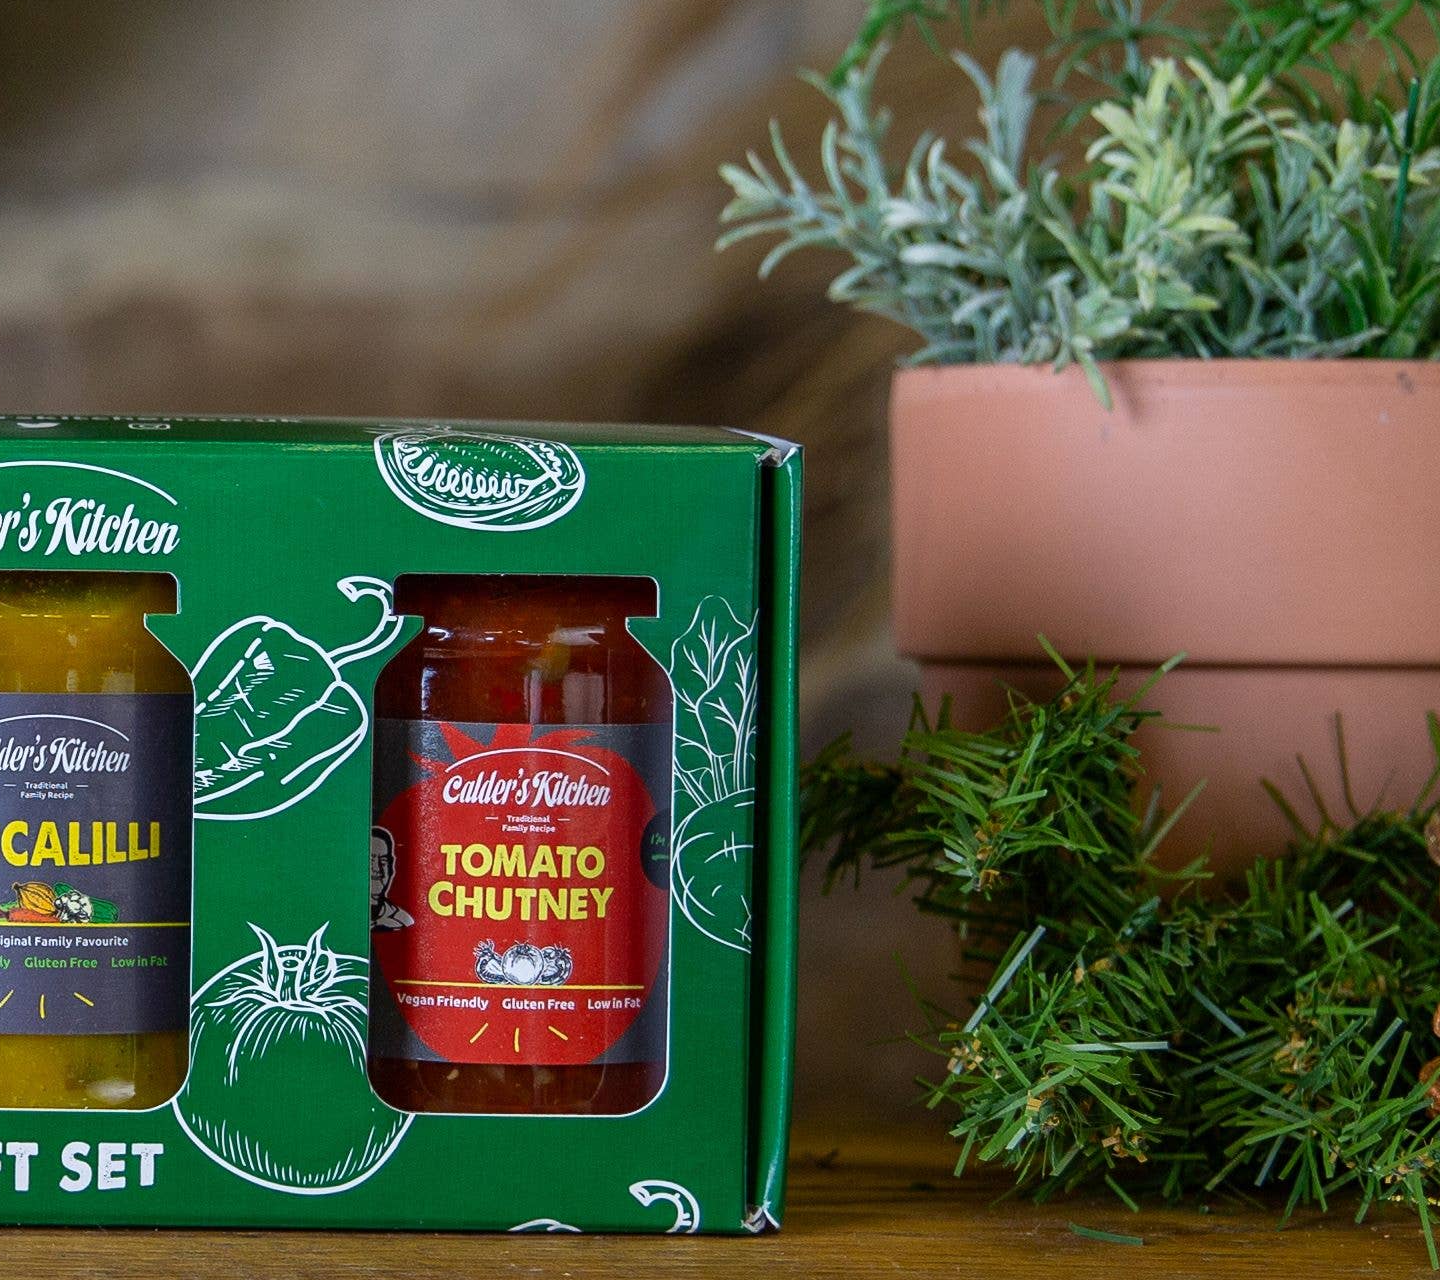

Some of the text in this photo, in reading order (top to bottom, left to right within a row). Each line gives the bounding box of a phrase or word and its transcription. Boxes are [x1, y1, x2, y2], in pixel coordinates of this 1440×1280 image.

[44, 497, 180, 556] Kitchen
[49, 737, 131, 773] Kitchen
[25, 781, 68, 790] Traditional
[443, 768, 611, 808] Calder's Kitchen
[20, 790, 74, 801] Family Recipe
[507, 814, 550, 824] Traditional
[501, 824, 556, 834] Family Recipe
[440, 843, 606, 880] TOMATO
[428, 881, 615, 921] CHUTNEY
[34, 935, 73, 949] Family
[75, 935, 129, 947] Favourite
[24, 955, 67, 969] Gluten
[70, 957, 98, 969] Free
[111, 956, 135, 967] Low
[137, 955, 148, 967] in
[150, 955, 168, 967] Fat
[397, 992, 641, 1011] Vegan Friendly Gluten Free Low in Fat
[58, 1140, 165, 1193] SET
